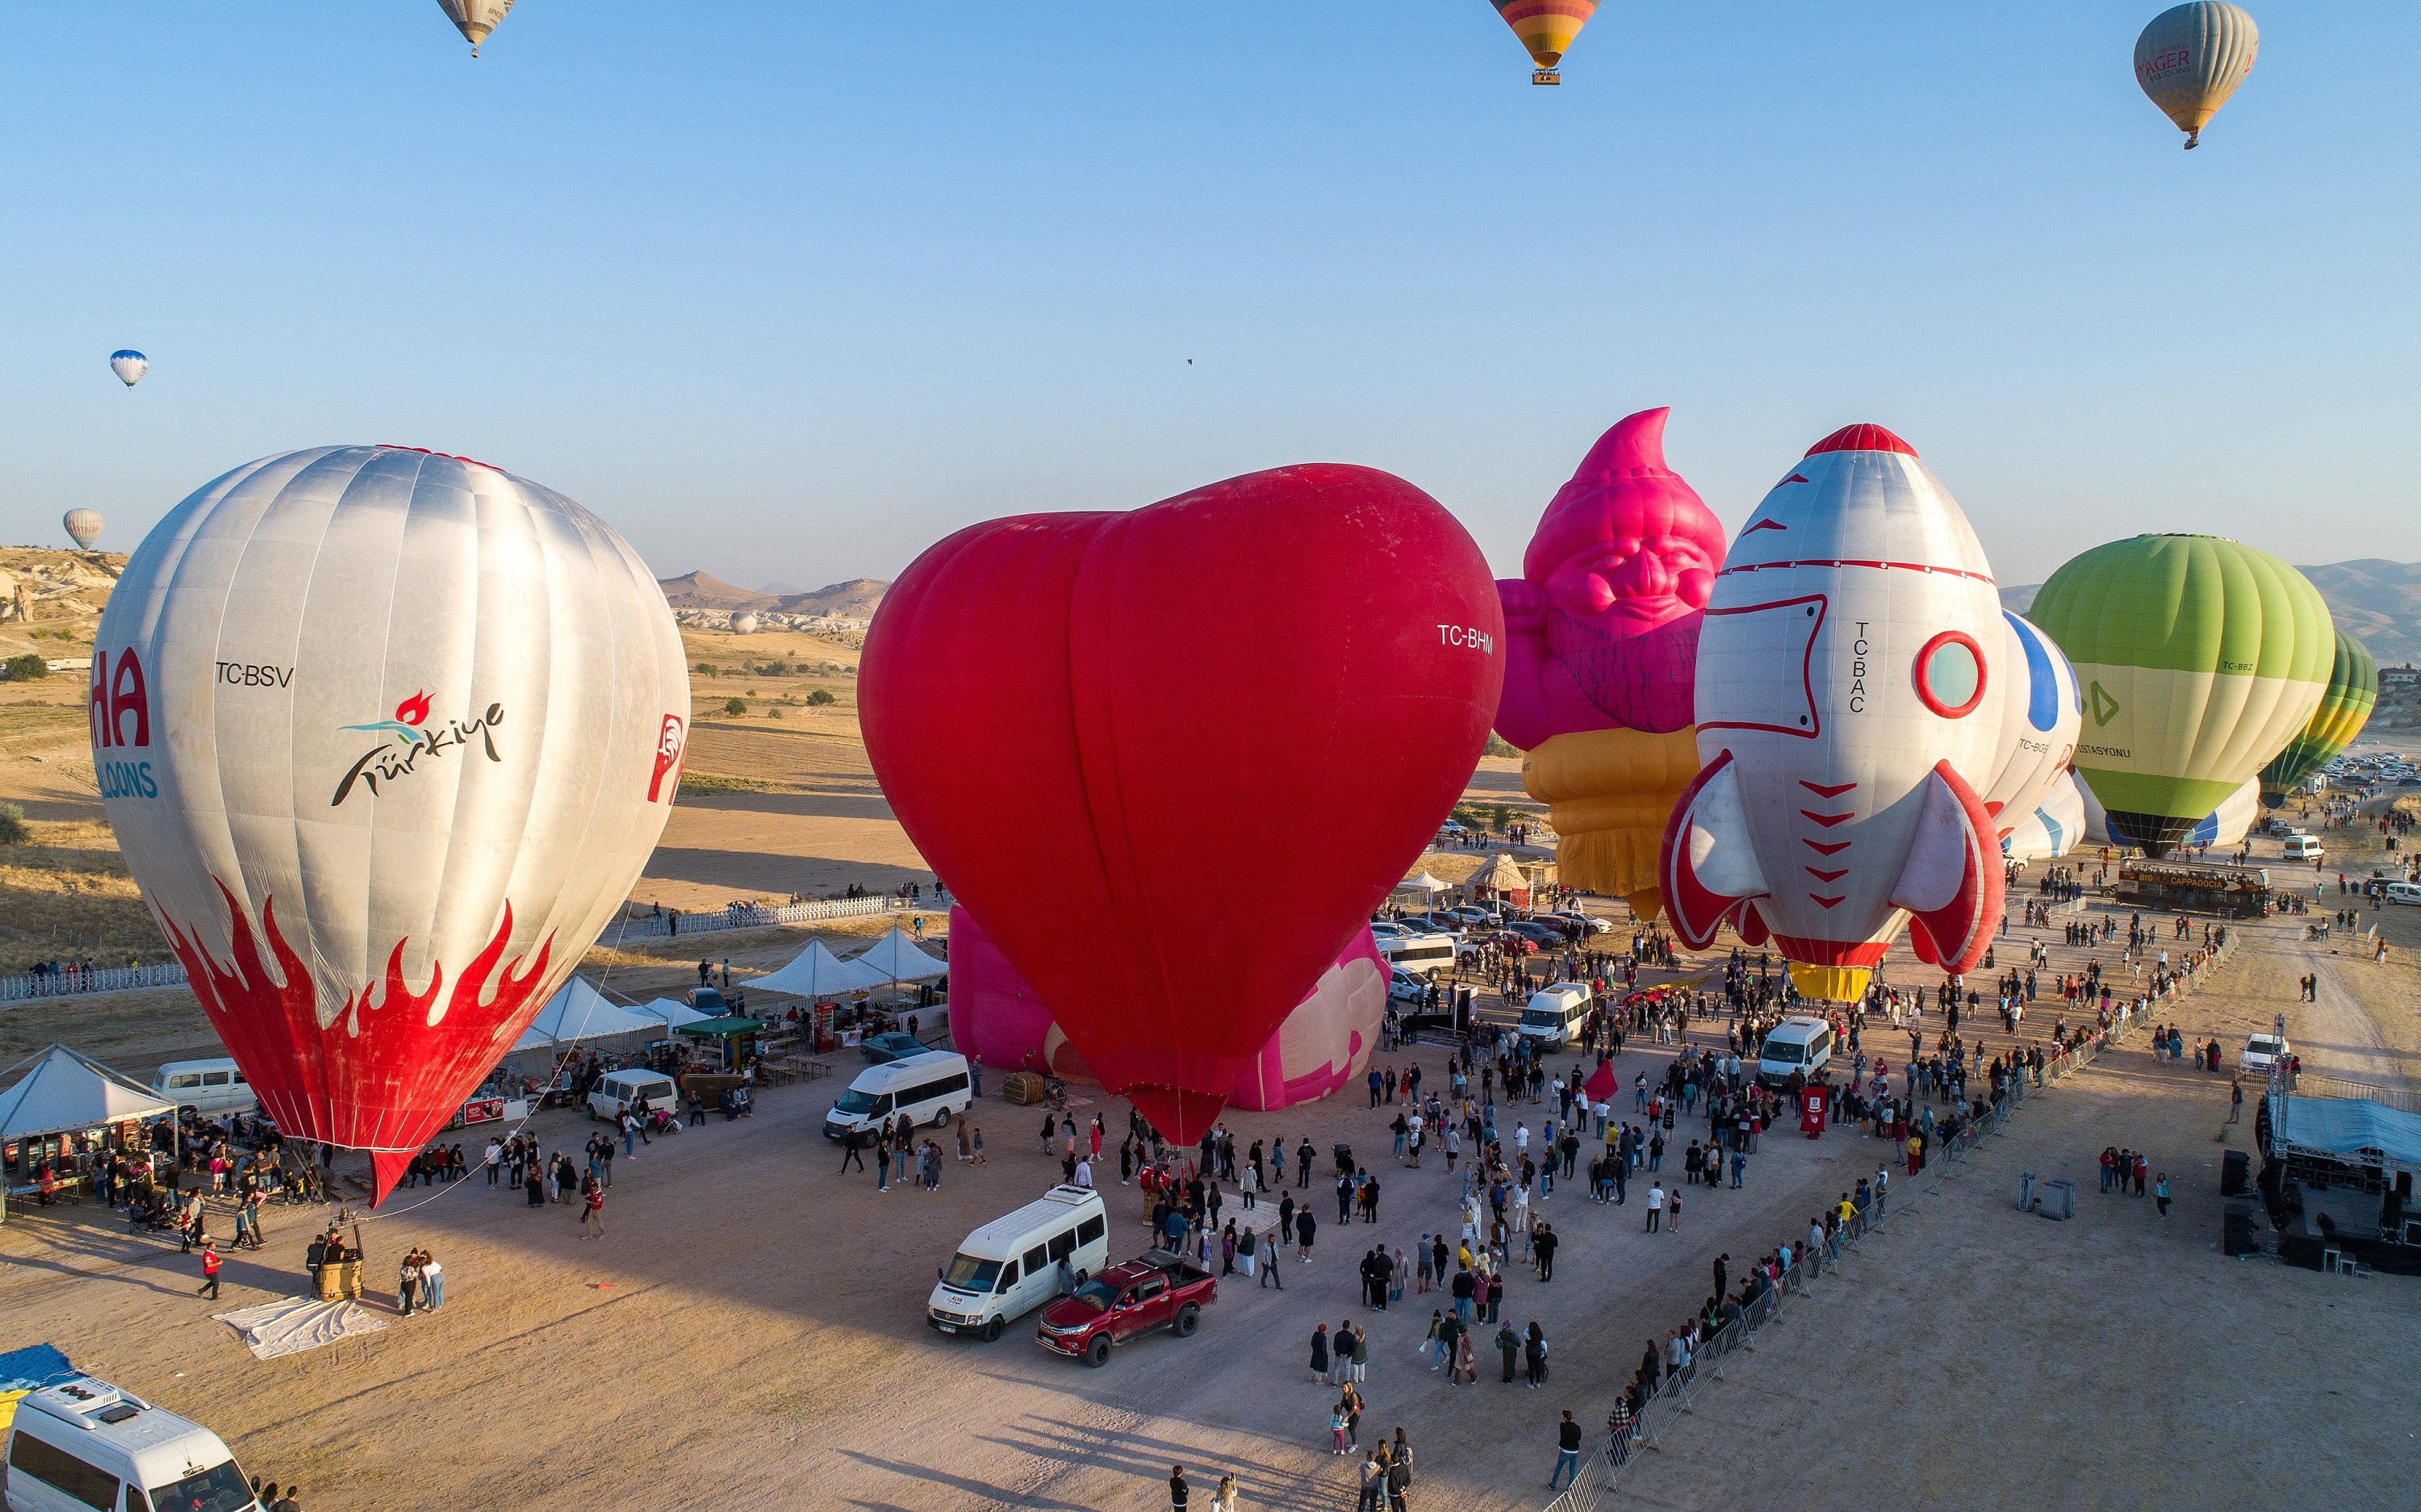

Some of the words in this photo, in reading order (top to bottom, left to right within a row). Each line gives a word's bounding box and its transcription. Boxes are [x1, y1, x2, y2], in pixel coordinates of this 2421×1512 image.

[1436, 624, 1493, 656] TC-BHM
[215, 662, 294, 688] TC-BSV
[1850, 621, 1869, 713] TC-BAC
[2223, 662, 2253, 670] TC-BBZ
[332, 703, 504, 807] Türkiye
[2171, 877, 2223, 889] CAPPADOCIA
